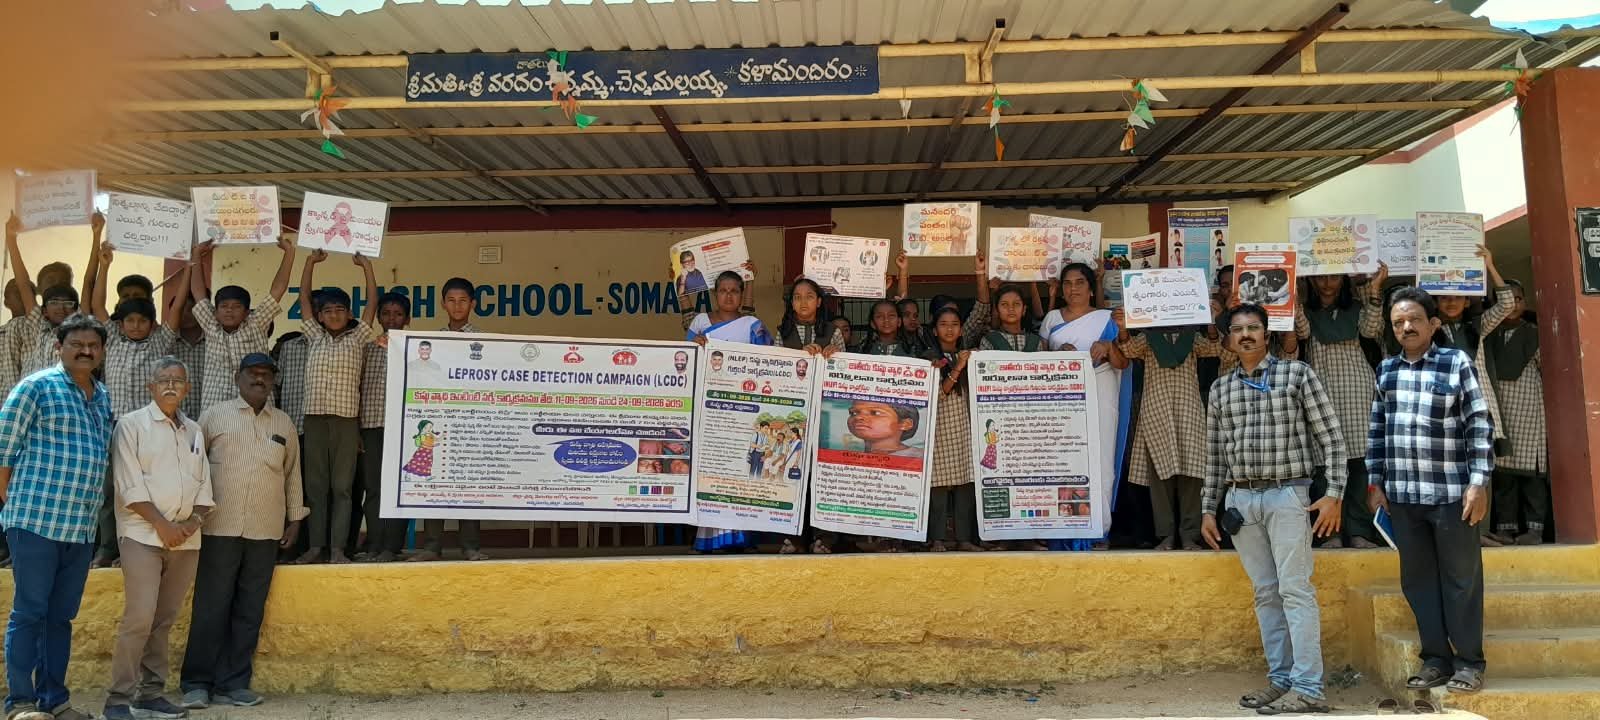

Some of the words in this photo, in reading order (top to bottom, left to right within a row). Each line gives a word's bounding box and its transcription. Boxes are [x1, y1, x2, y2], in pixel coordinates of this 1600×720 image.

[487, 72, 543, 93] వరదం
[738, 57, 853, 83] కళామందిరం
[148, 218, 179, 229] గురించి
[448, 367, 497, 381] LEPROSY
[501, 369, 529, 382] CASE
[532, 370, 593, 385] DETECTION
[596, 371, 651, 386] CAMPAIGN
[653, 372, 688, 388] (LCDC)
